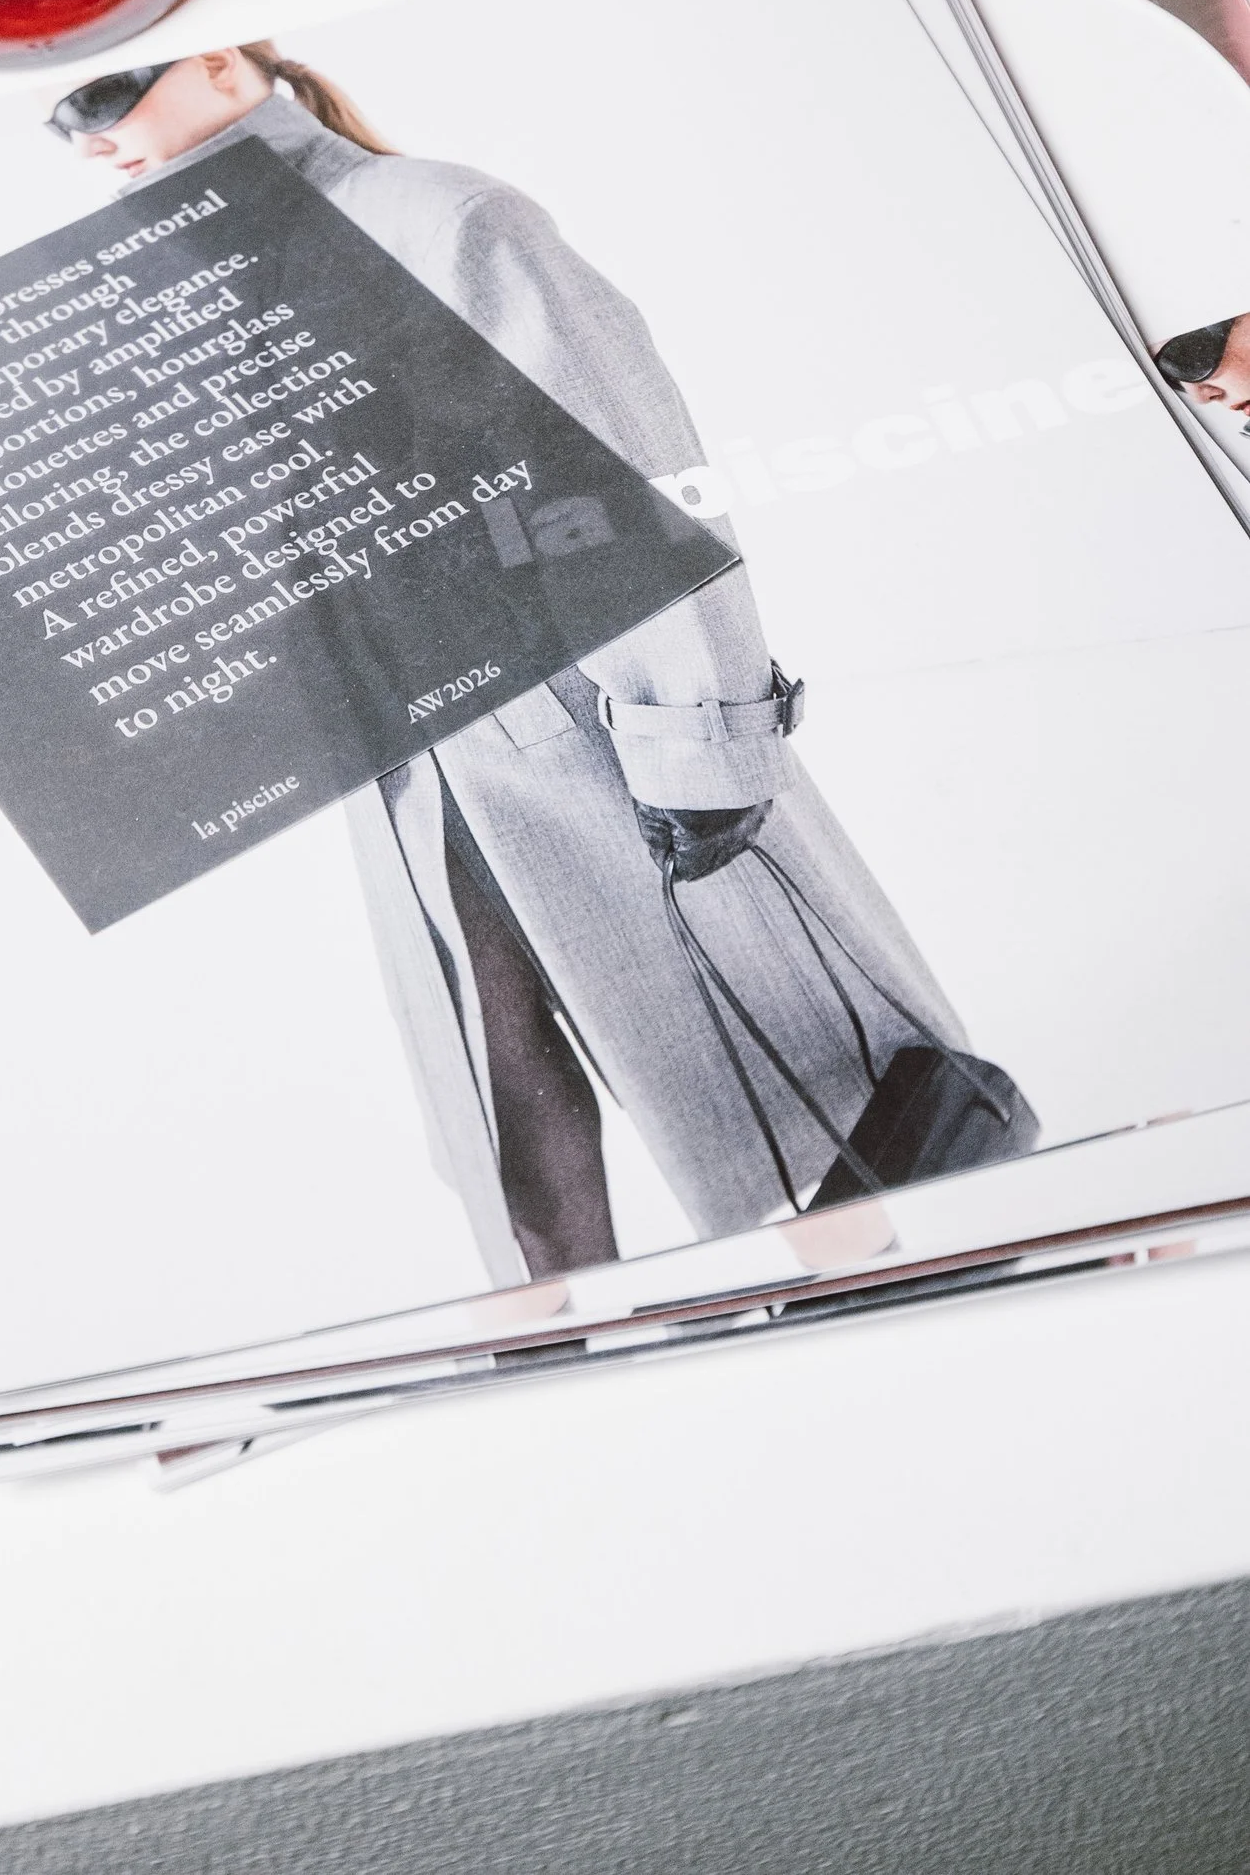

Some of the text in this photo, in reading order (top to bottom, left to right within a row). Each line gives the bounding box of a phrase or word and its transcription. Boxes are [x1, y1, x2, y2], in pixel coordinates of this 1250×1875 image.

[96, 188, 229, 266] sartorial
[0, 273, 137, 344] through
[115, 253, 259, 325] elegance.
[31, 368, 82, 401] by
[89, 286, 244, 375] amplified
[131, 303, 295, 388] hourglass
[132, 381, 200, 429] and
[200, 331, 316, 403] precise
[110, 456, 215, 519] dressy
[222, 422, 292, 462] ease
[291, 377, 378, 425] with
[129, 432, 190, 467] the
[194, 350, 357, 437] collection
[648, 357, 1150, 547] piscine
[12, 438, 334, 608] metropolitan cool.
[42, 451, 382, 640] A refined, powerful
[60, 472, 437, 669] wardrobe designed to
[88, 459, 533, 706] move seamlessly from day
[114, 650, 278, 738] to night.
[407, 660, 502, 725] AW2026
[191, 776, 300, 840] la piscine
